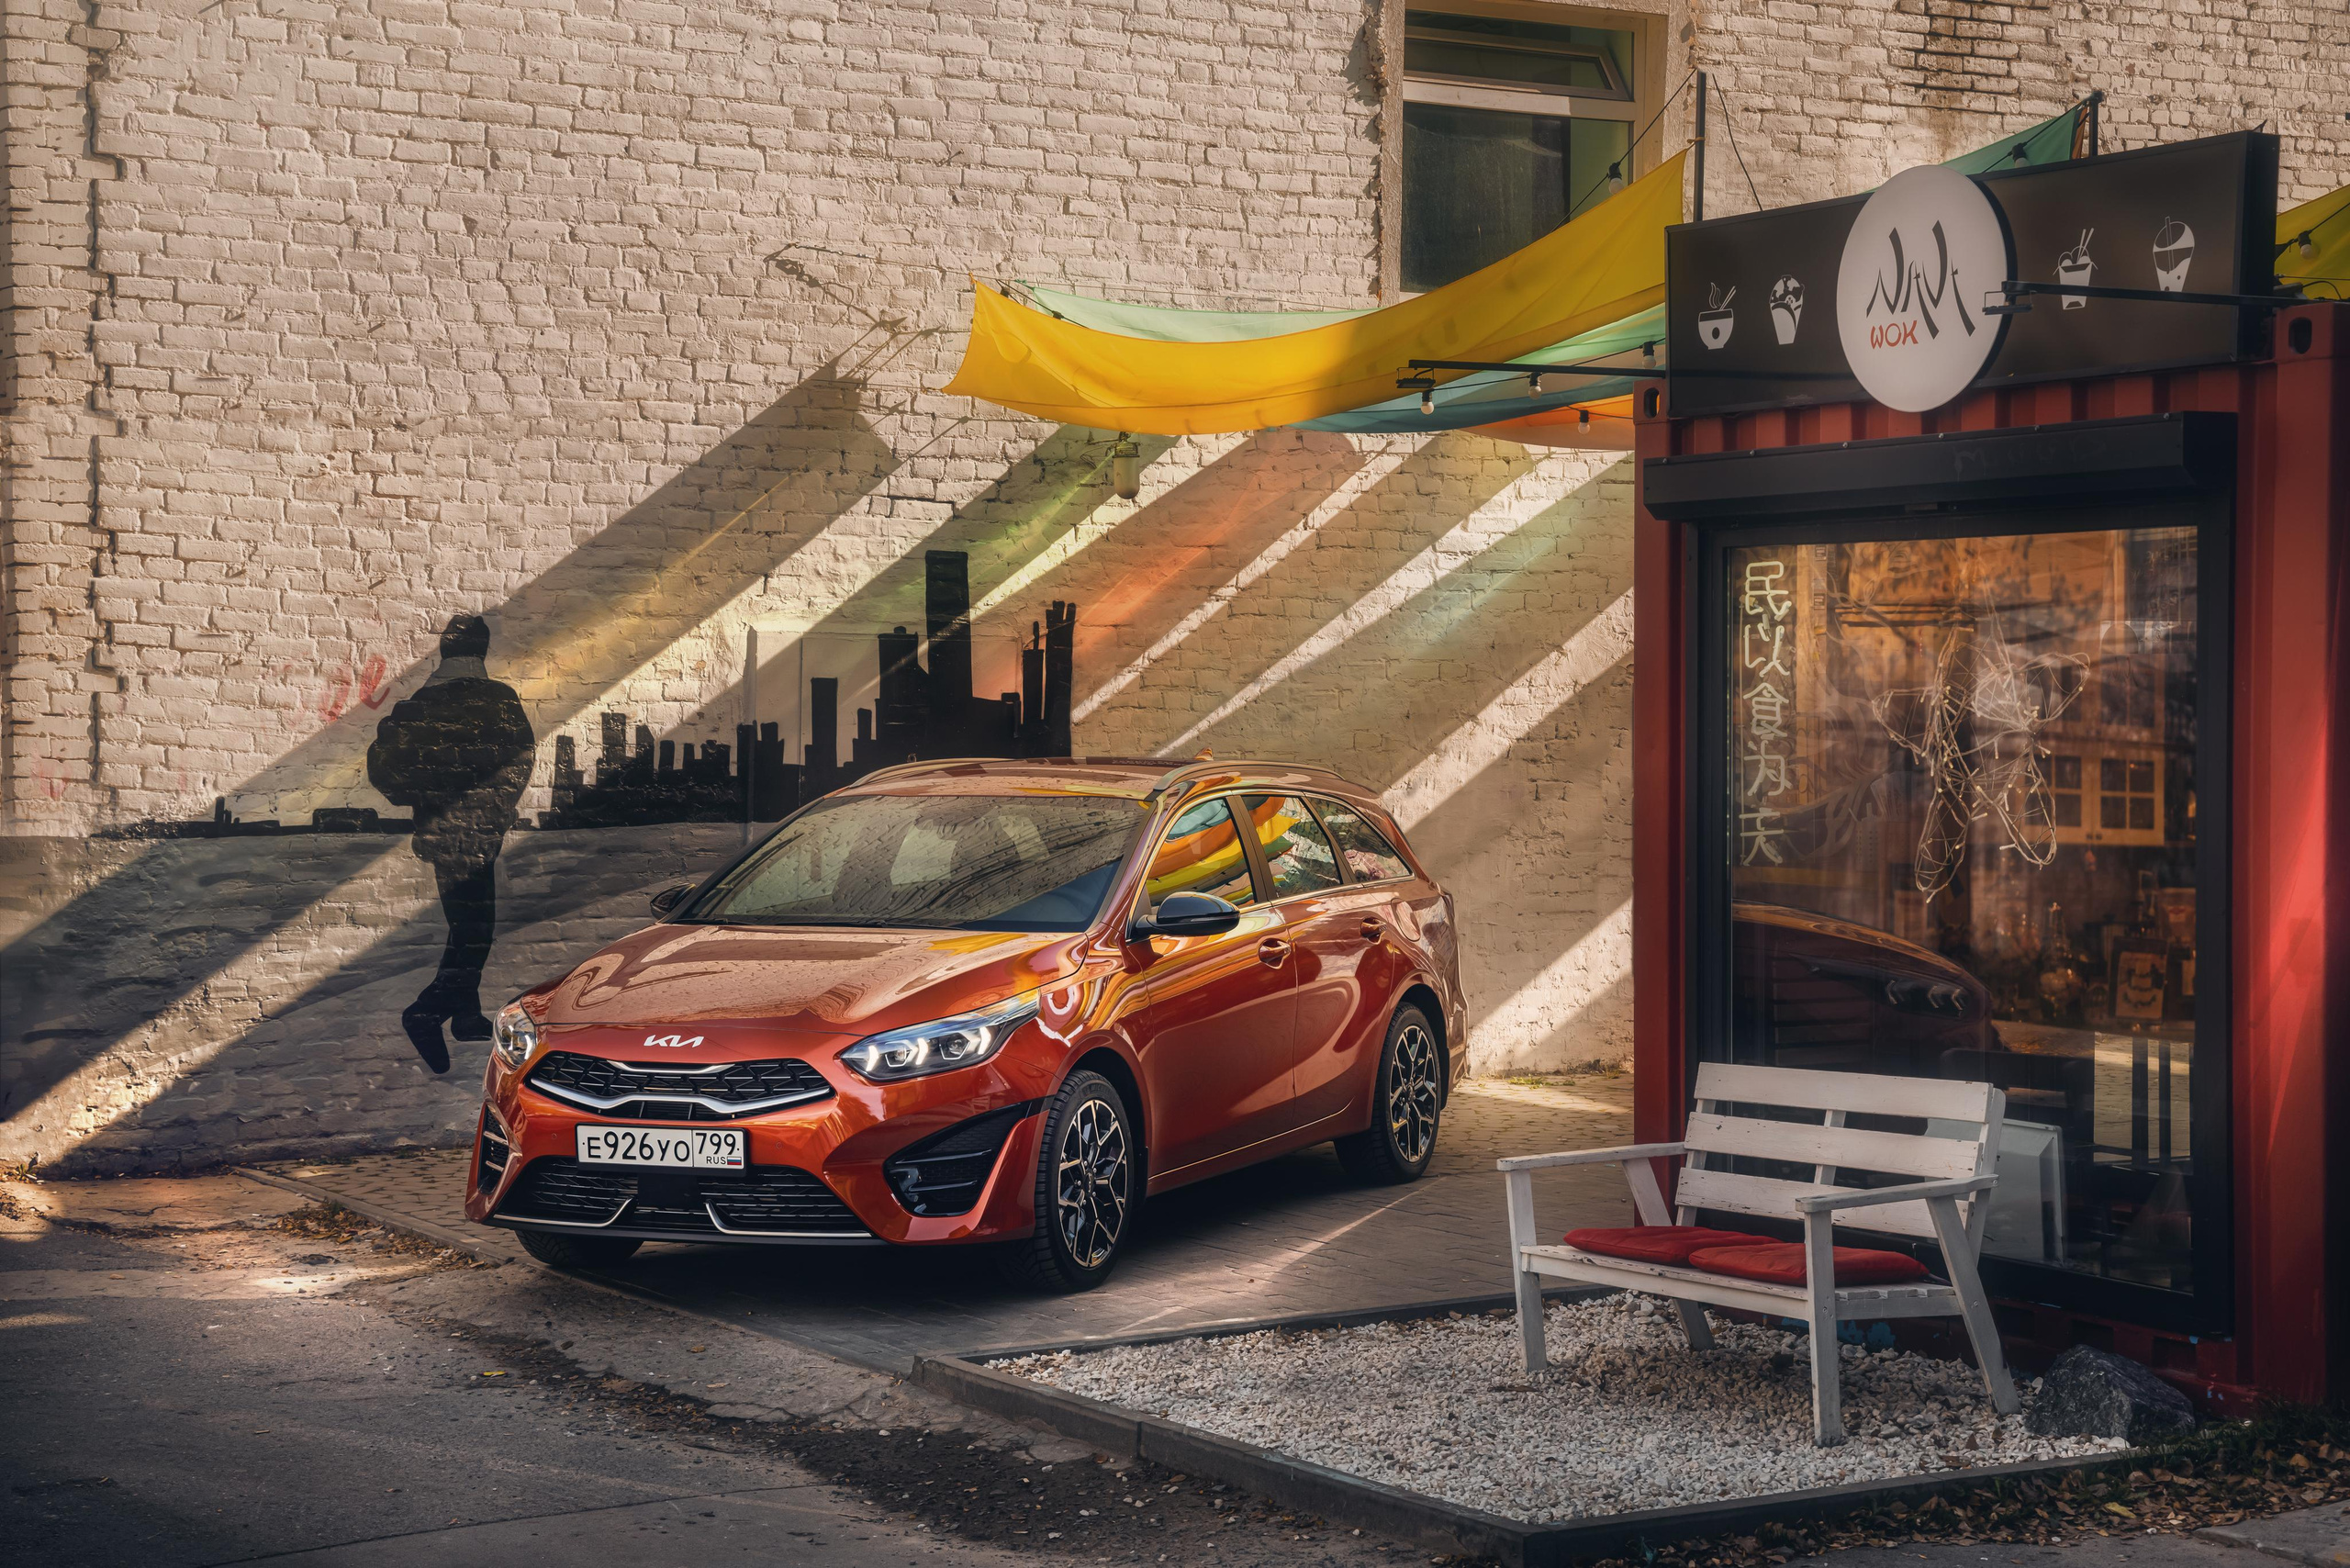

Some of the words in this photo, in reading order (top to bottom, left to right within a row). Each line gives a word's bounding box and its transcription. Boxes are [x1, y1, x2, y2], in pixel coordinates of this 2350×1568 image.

[1871, 320, 1919, 350] WOK
[643, 1035, 705, 1048] KIA
[695, 1132, 736, 1156] 799
[706, 1156, 726, 1165] RUS
